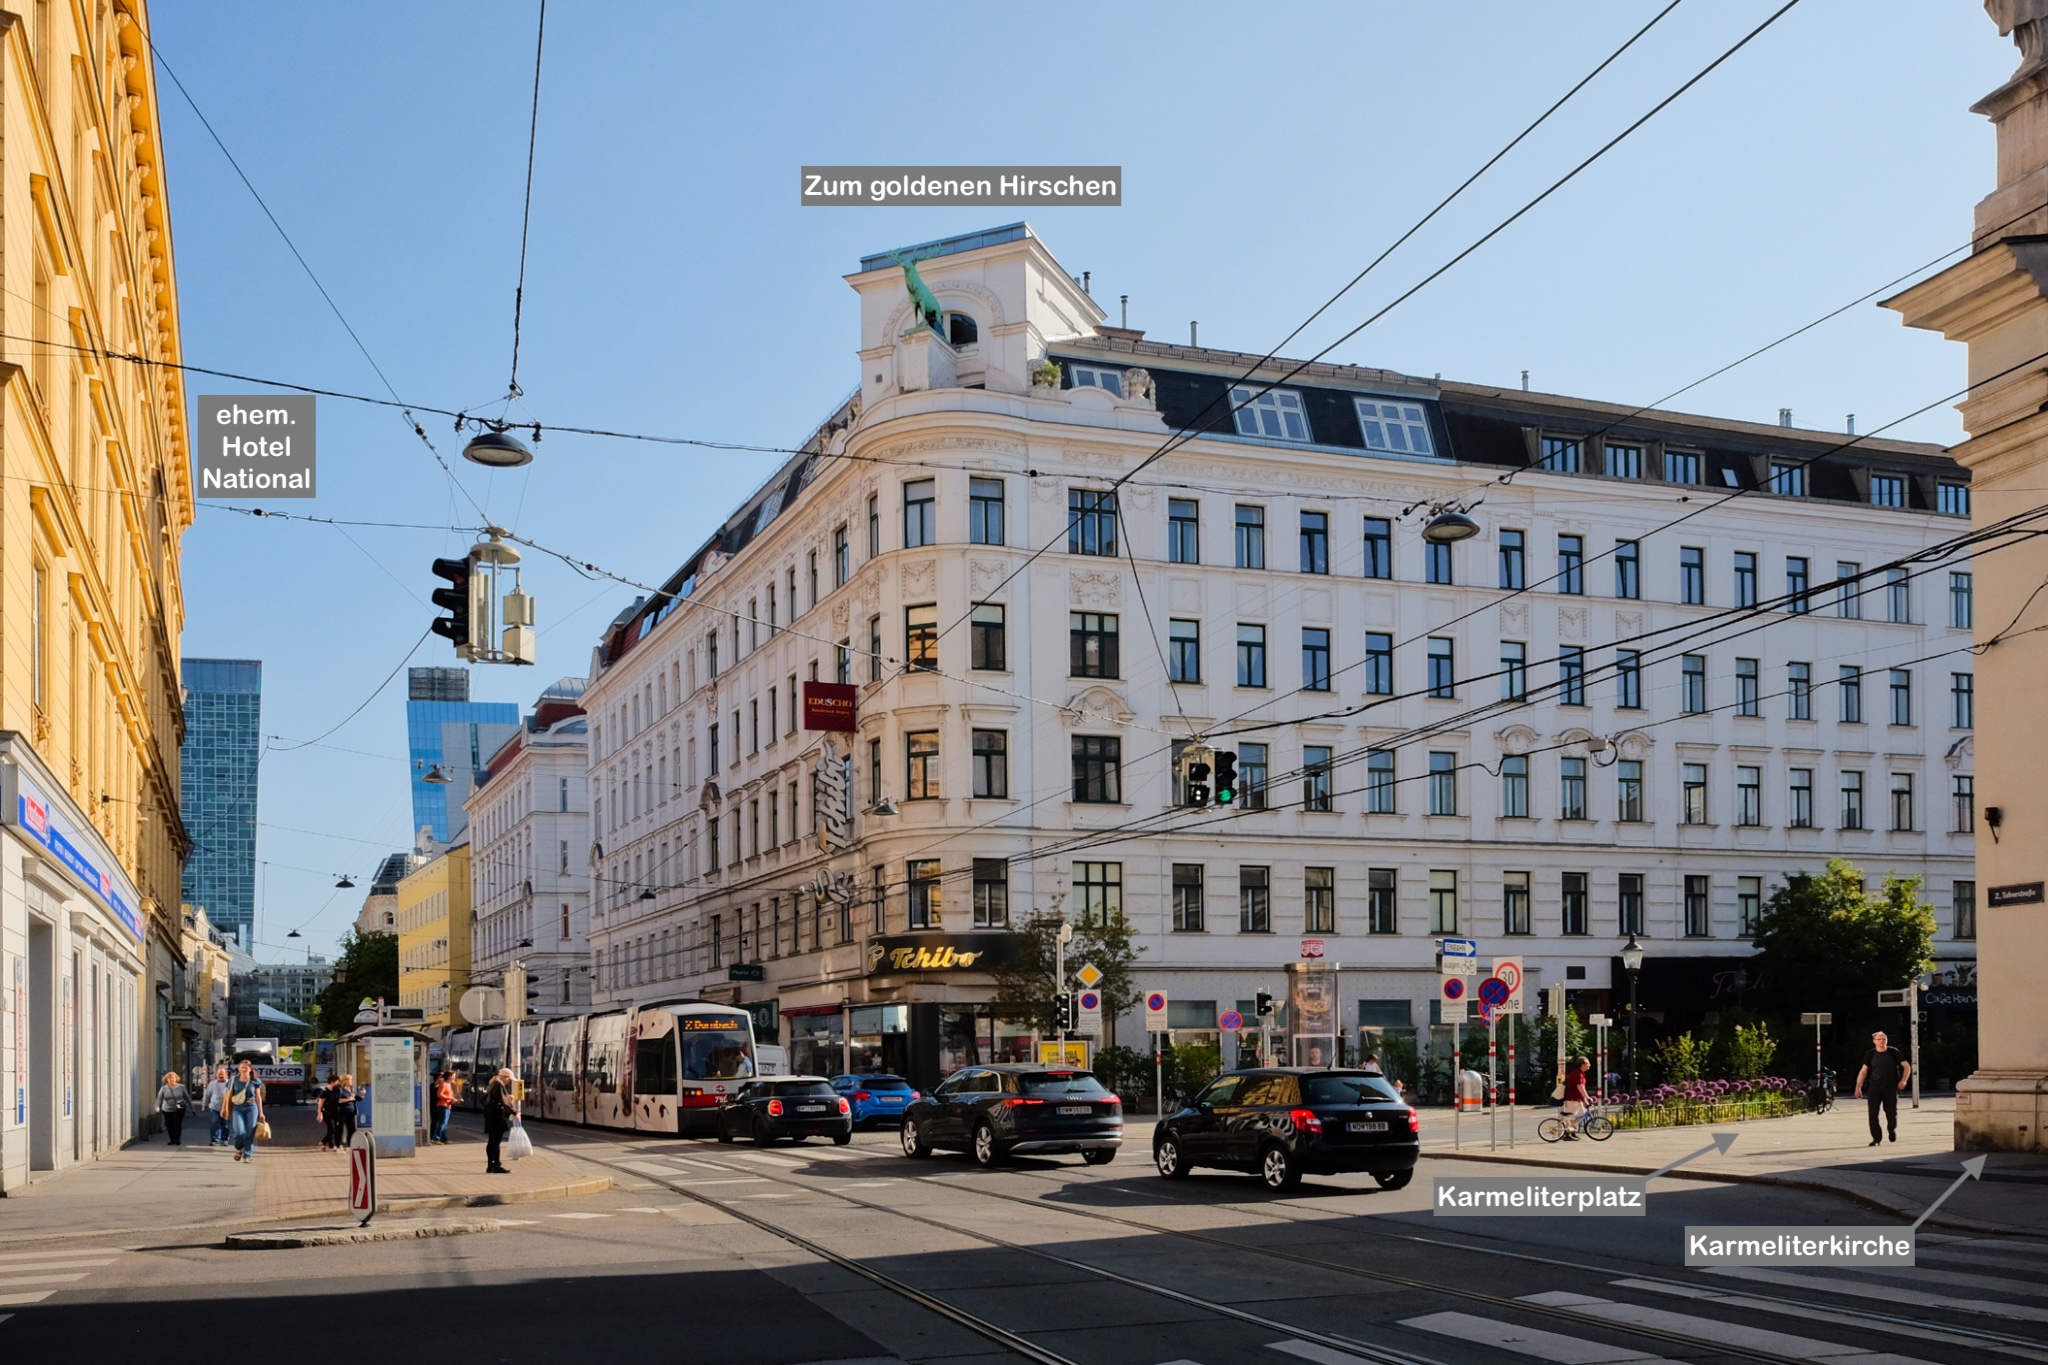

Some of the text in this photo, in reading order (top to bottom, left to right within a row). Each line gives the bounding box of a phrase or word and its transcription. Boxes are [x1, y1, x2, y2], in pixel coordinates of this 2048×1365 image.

[808, 697, 853, 708] EDUSCHO
[815, 739, 846, 854] Tchibo
[1446, 943, 1466, 952] EINBAHN
[889, 945, 984, 969] Tchibo
[1501, 970, 1515, 986] 30
[694, 1019, 738, 1030] Dornbach
